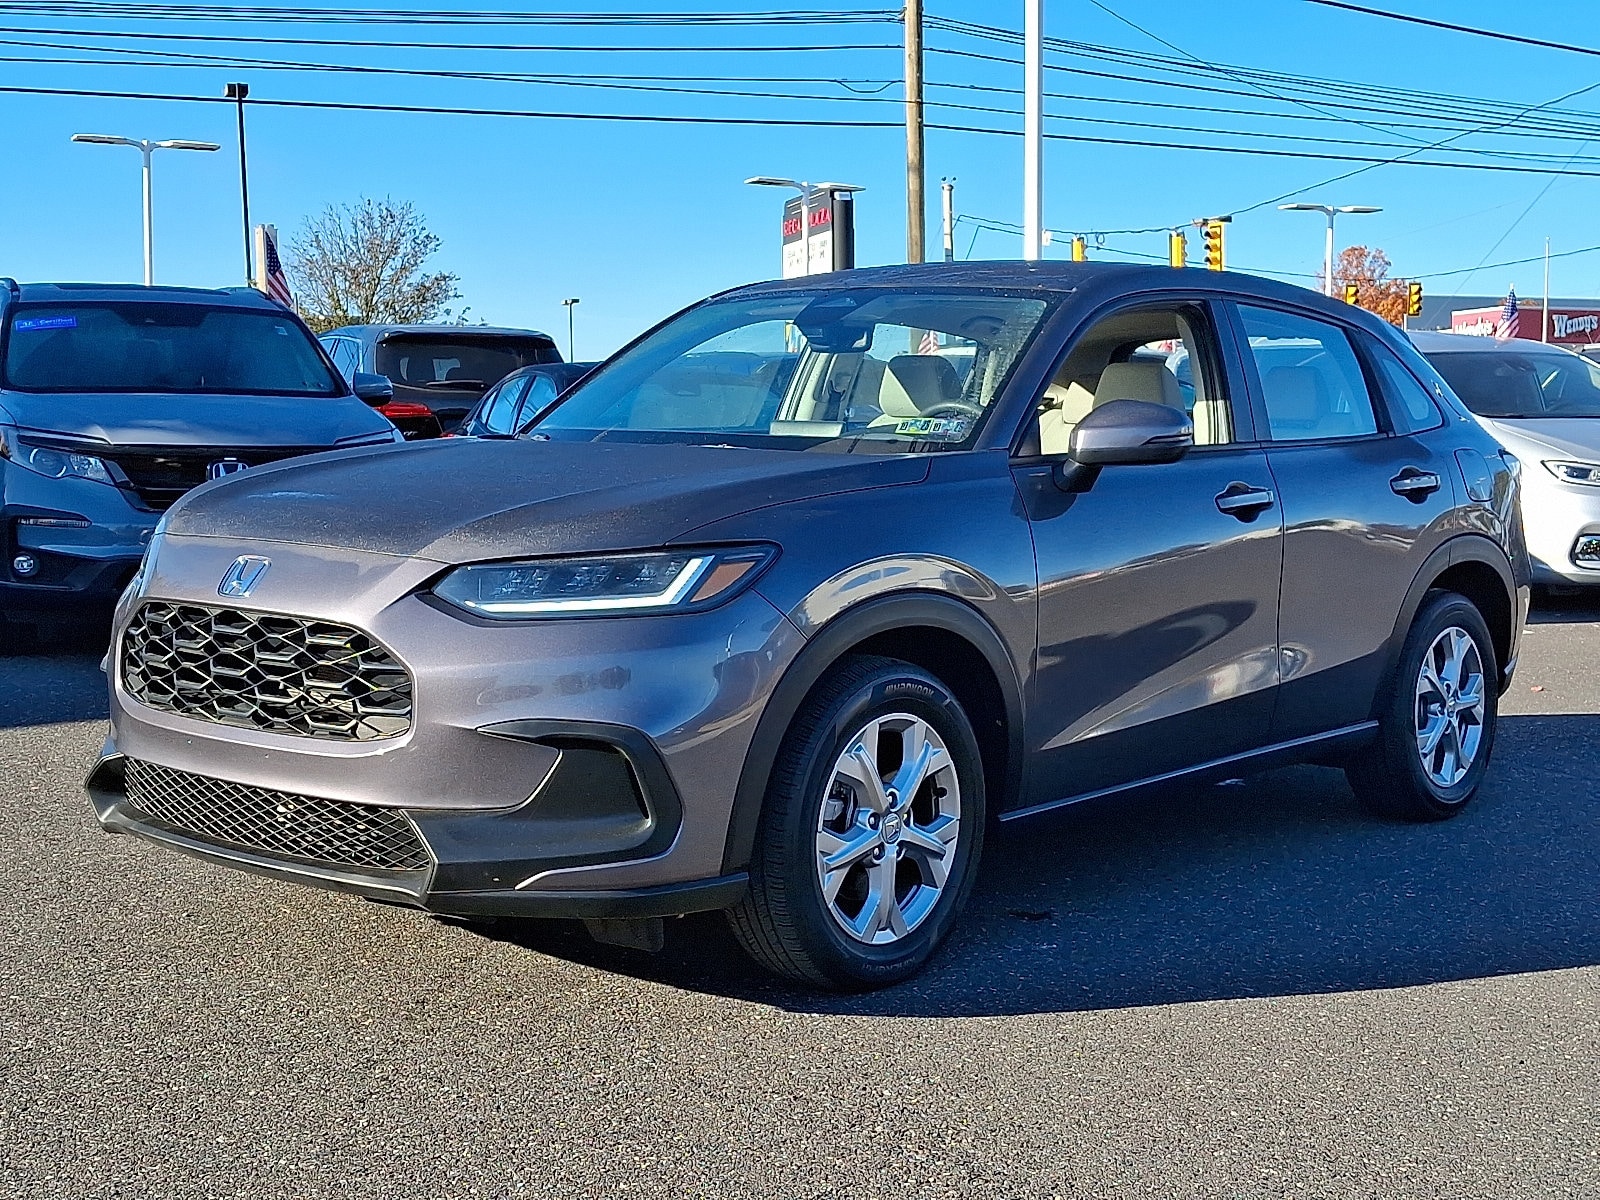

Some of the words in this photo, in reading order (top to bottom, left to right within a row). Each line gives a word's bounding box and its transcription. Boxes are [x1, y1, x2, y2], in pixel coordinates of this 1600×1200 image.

[784, 218, 803, 236] REGA
[807, 207, 832, 227] LAZA
[1552, 313, 1598, 338] Wendy's
